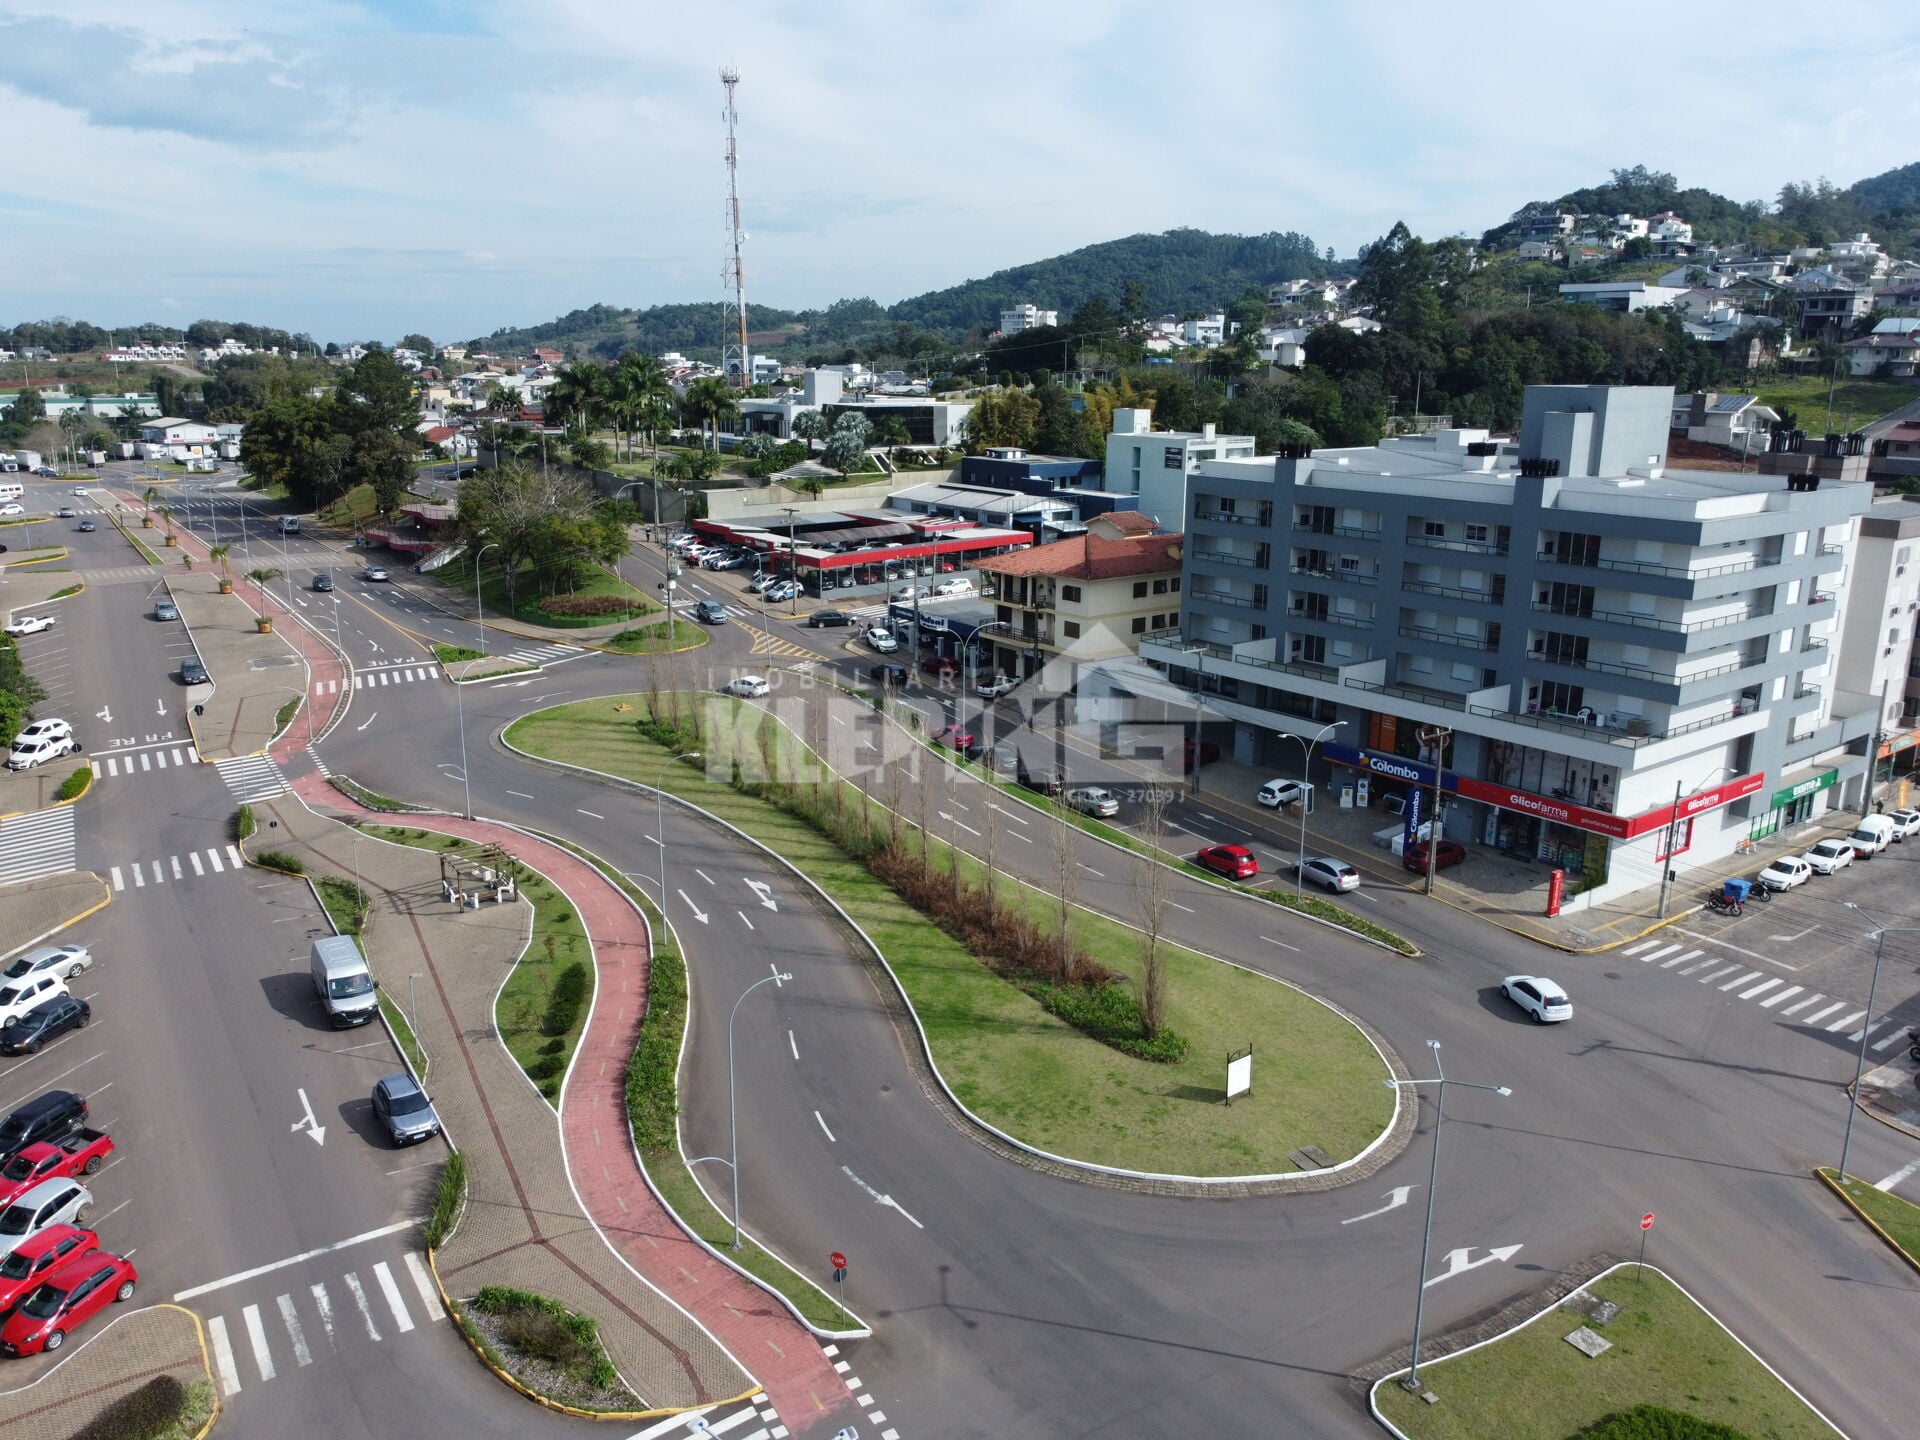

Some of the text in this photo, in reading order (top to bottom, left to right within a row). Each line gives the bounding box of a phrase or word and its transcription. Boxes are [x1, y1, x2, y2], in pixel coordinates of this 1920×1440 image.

[1370, 758, 1419, 780] Colombo
[1410, 791, 1420, 833] Colombo
[1510, 794, 1568, 818] Glicofarma
[831, 1255, 845, 1265] PARE
